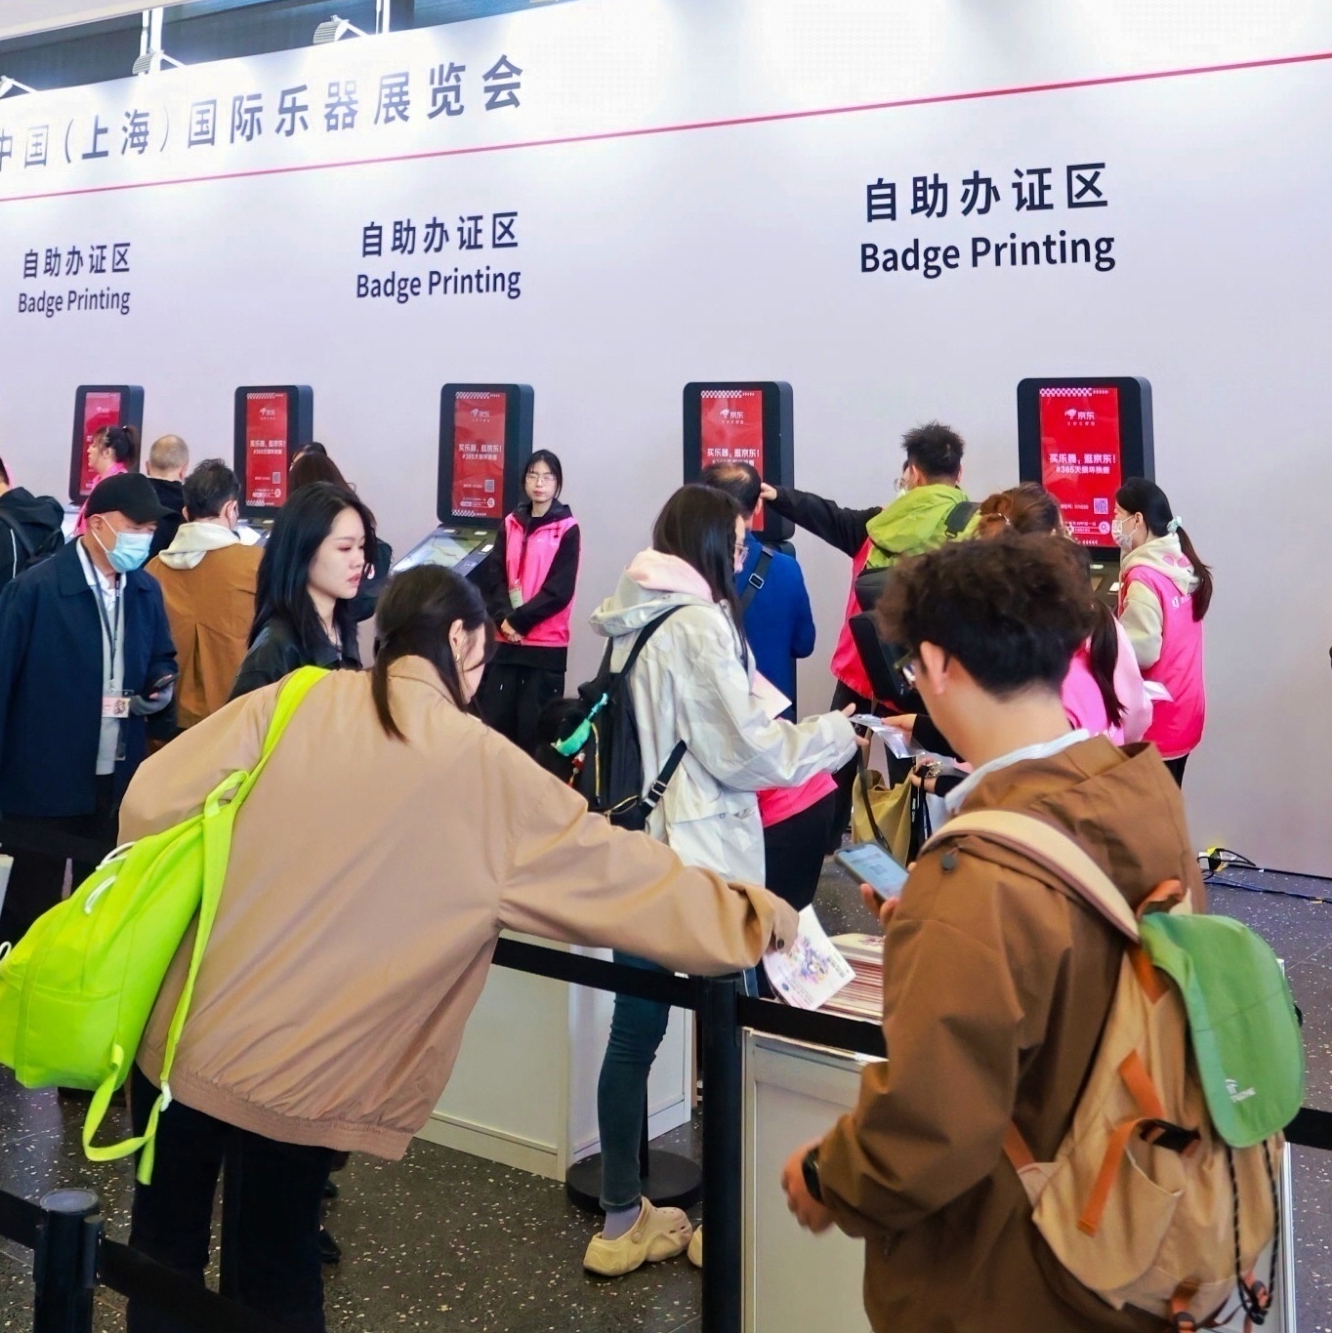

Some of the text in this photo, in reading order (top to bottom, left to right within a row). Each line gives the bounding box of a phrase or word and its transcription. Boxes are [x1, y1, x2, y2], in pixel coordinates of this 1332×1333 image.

[865, 161, 1110, 223] 自助办证区
[360, 210, 520, 259] 自助办证区
[859, 228, 1117, 279] Badge Printing
[22, 242, 131, 280] 自助办证区
[17, 287, 131, 319] Badge Printing
[355, 264, 522, 304] Badge Printing
